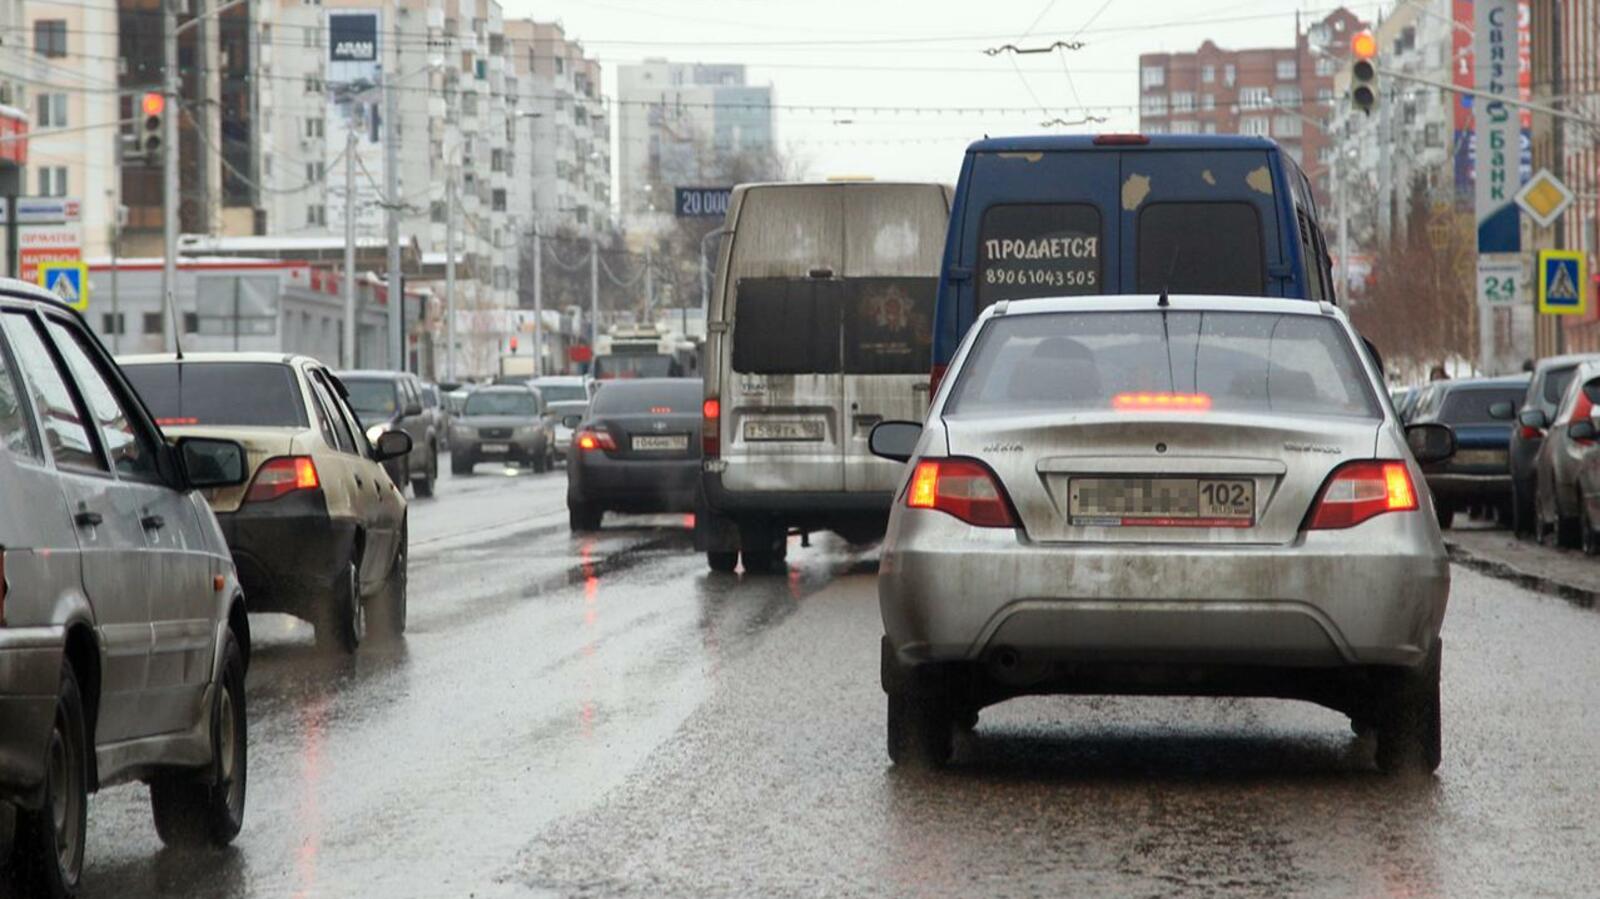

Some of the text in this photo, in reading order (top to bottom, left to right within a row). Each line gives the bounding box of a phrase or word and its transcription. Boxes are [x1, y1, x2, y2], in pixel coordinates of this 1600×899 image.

[1490, 130, 1505, 200] Банк
[682, 191, 701, 214] 20
[985, 237, 1098, 260] ПРОДАЕТСЯ
[986, 269, 1096, 286] 89061043505
[1485, 275, 1515, 293] 24
[1202, 483, 1244, 505] 102
